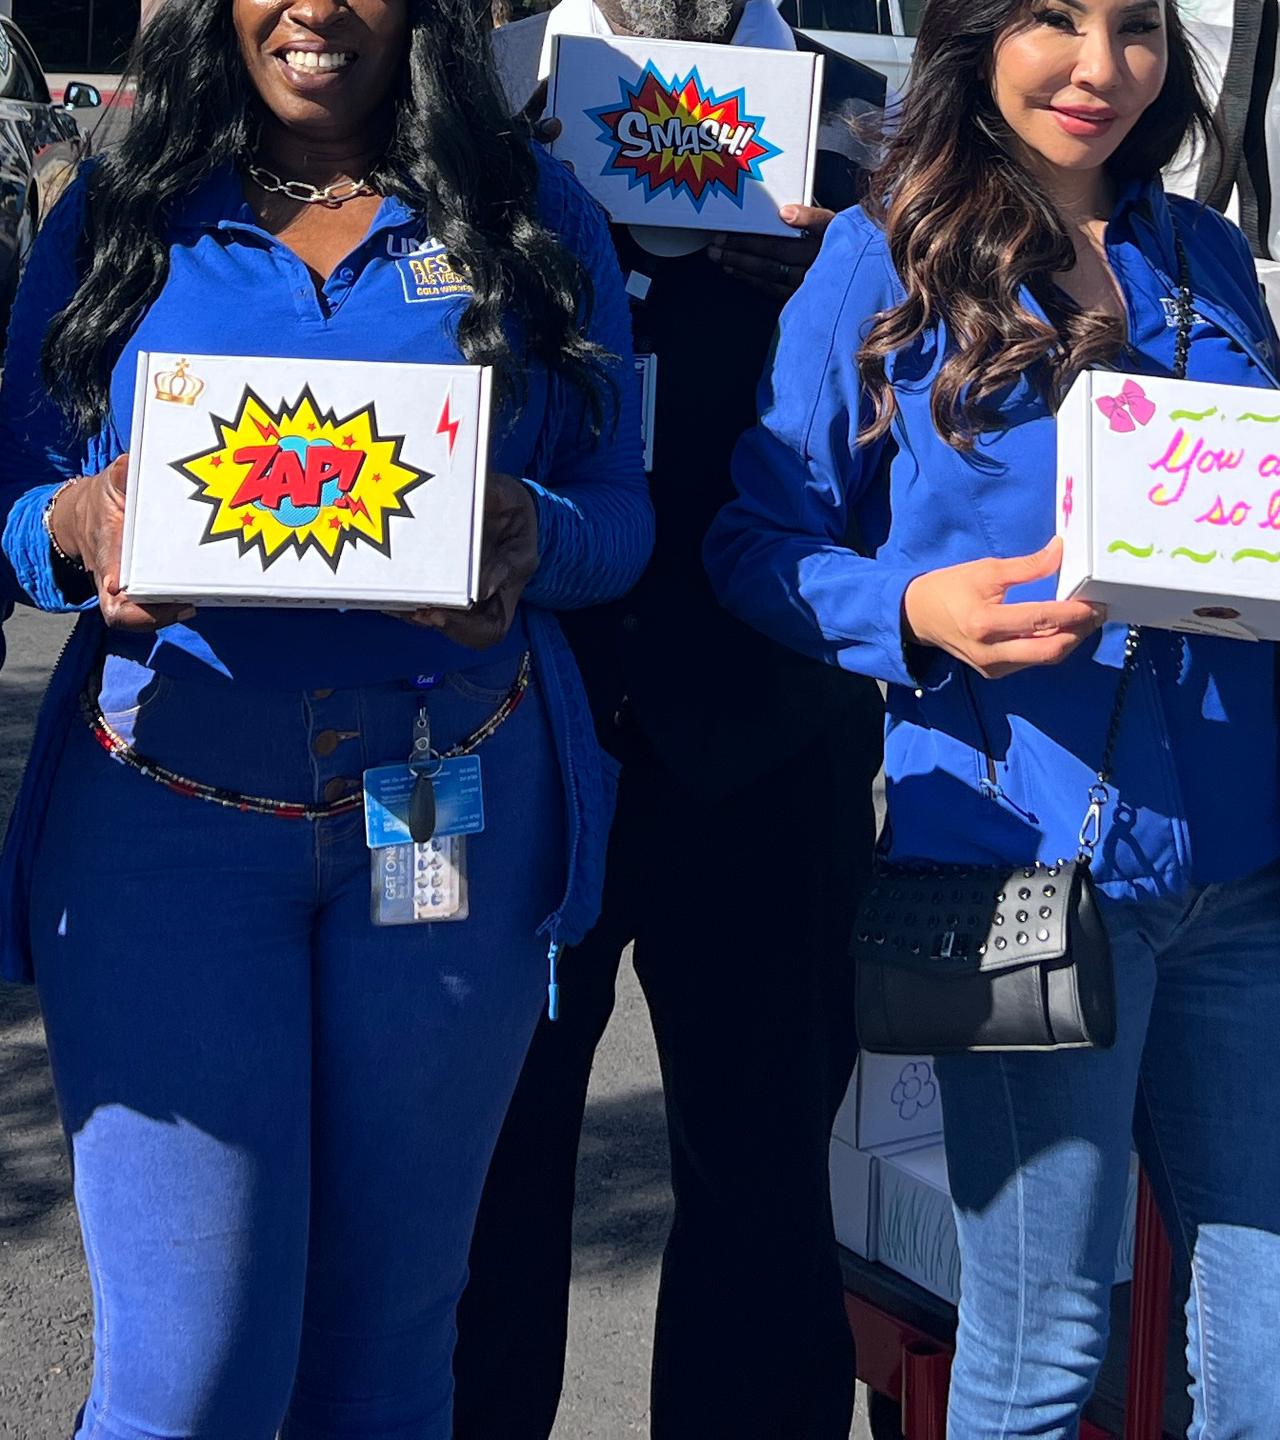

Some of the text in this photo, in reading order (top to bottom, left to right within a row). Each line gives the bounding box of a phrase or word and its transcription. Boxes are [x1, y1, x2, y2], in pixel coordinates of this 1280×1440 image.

[617, 111, 756, 158] SMASH!
[409, 254, 451, 276] BES
[230, 445, 367, 510] ZAP!
[1148, 427, 1245, 507] You
[1194, 495, 1252, 527] so
